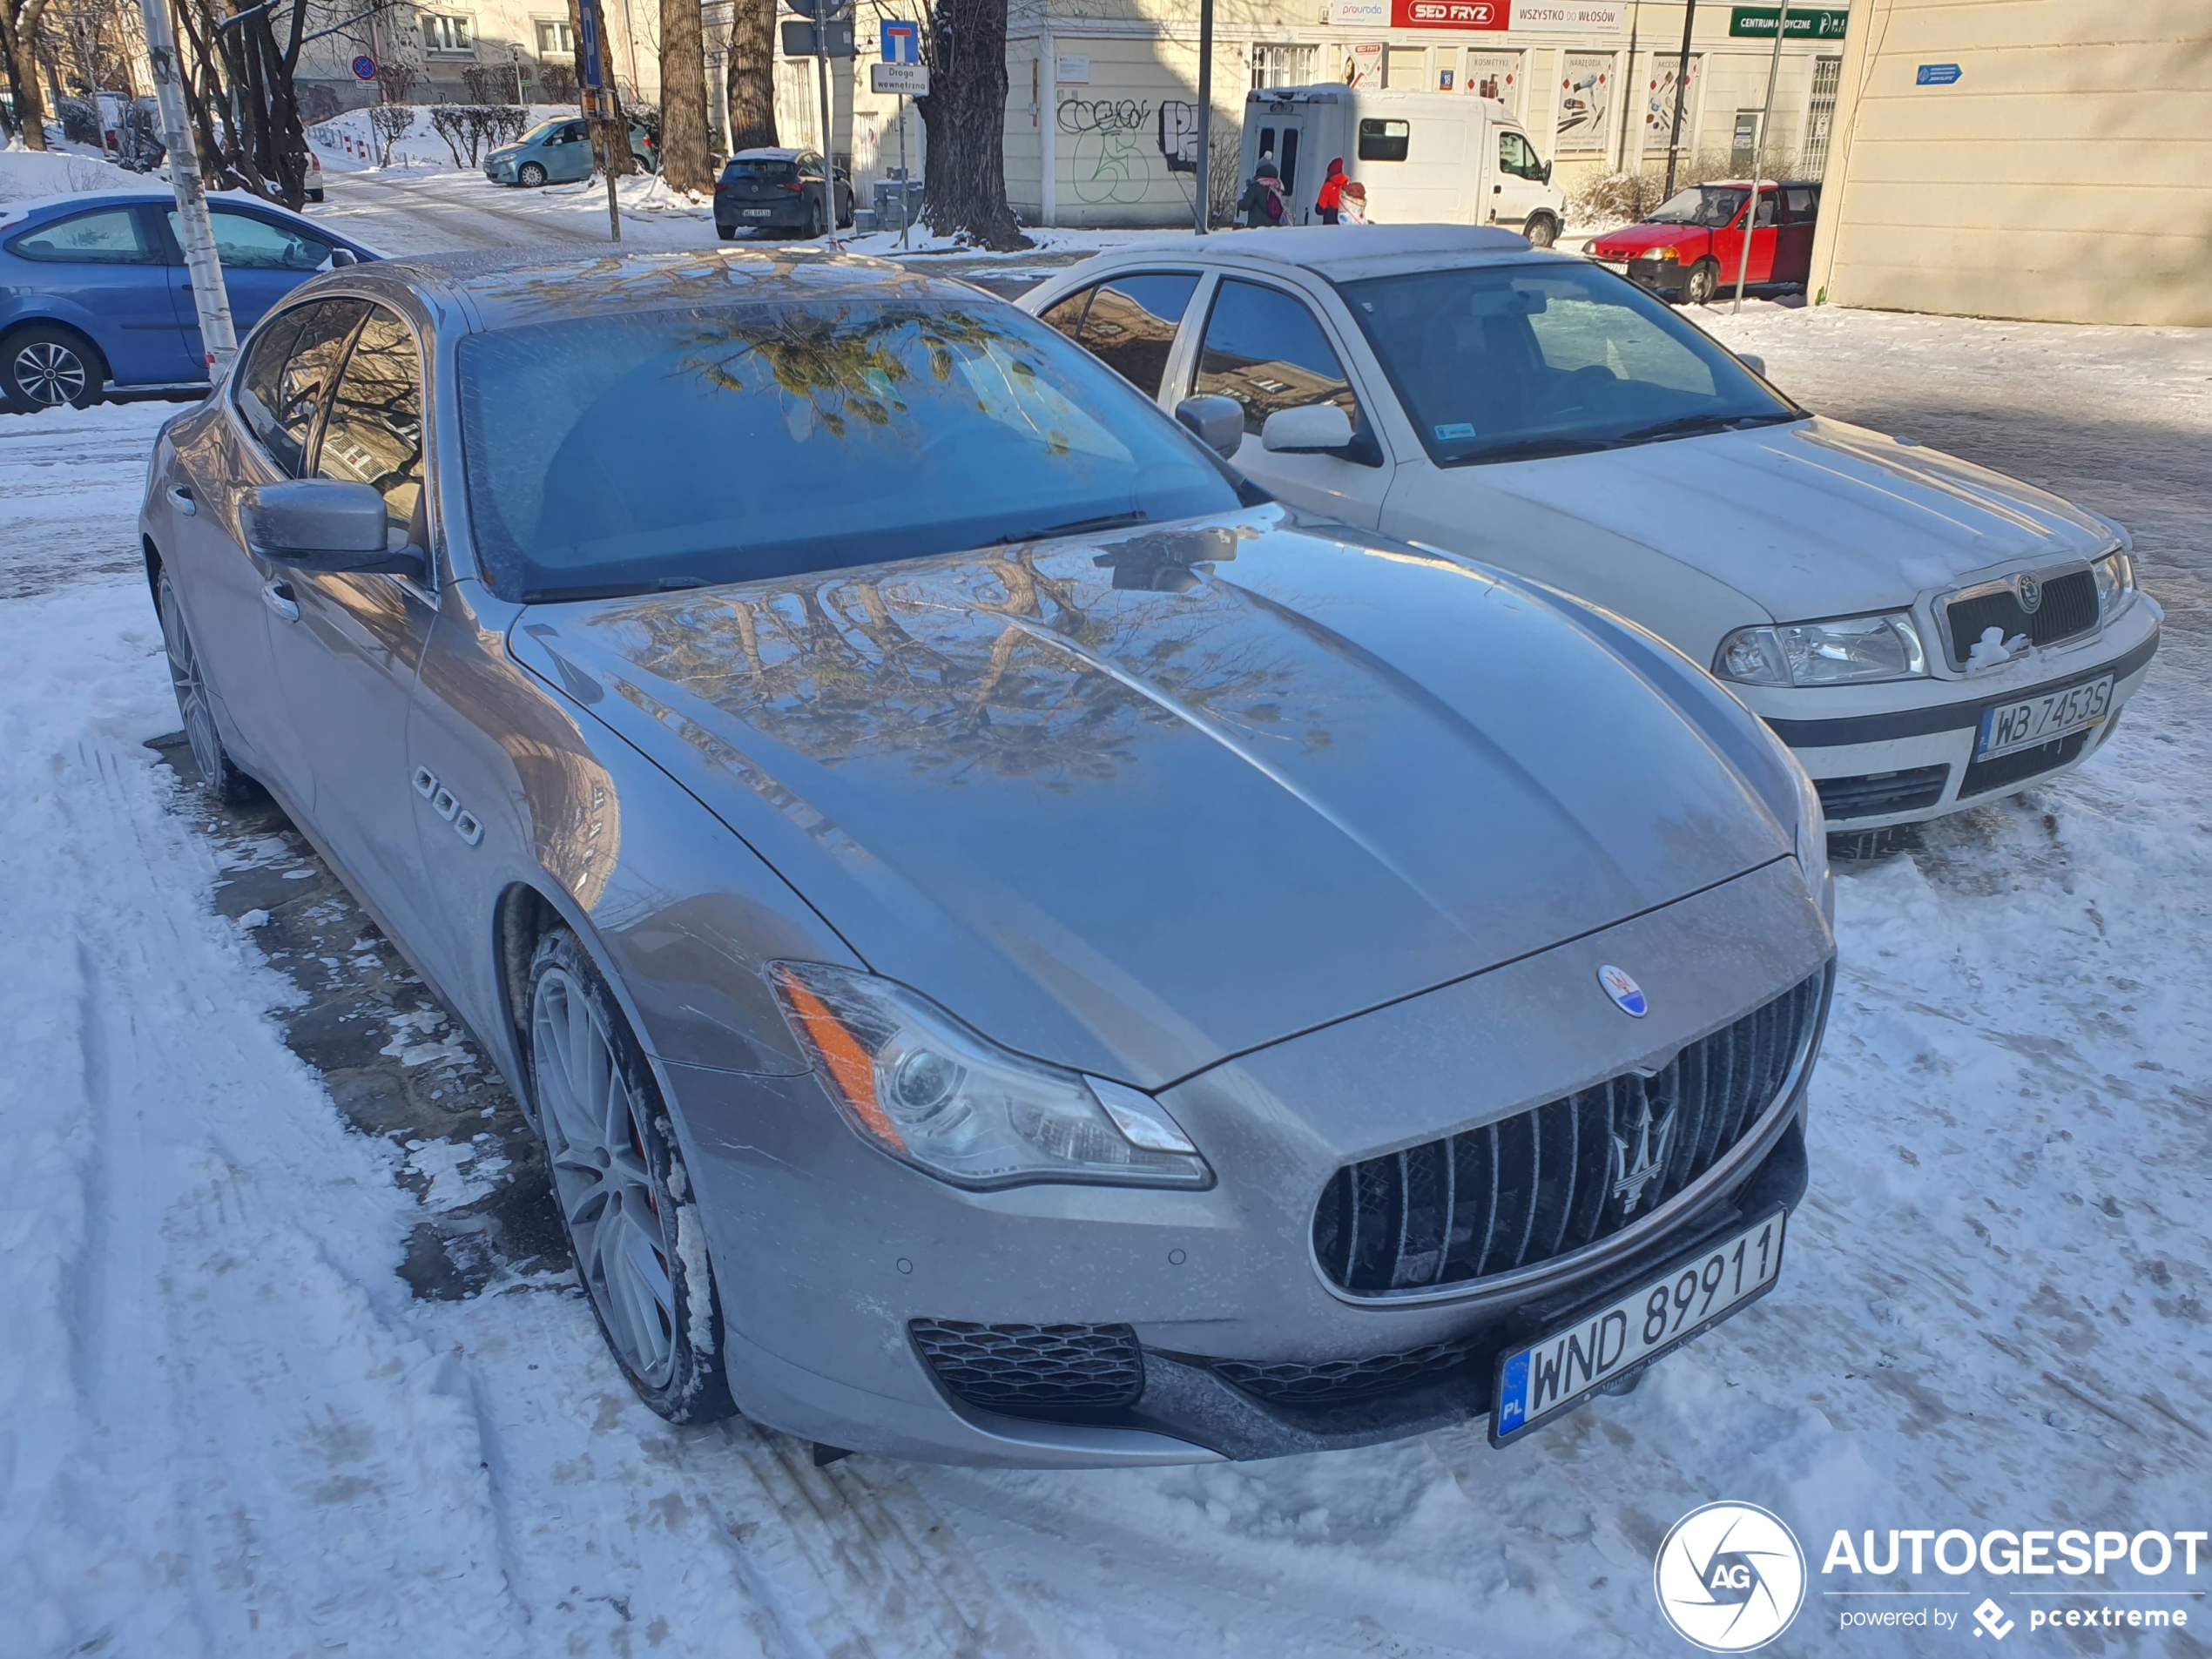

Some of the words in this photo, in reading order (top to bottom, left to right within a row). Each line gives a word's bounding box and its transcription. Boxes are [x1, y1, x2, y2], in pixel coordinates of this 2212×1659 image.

[1343, 3, 1382, 15] prouroda
[1415, 5, 1447, 18] SED
[1450, 7, 1487, 19] FRYZ
[1520, 9, 1564, 21] WSZYSTKO
[1567, 11, 1576, 21] DO
[1579, 9, 1615, 22] WŁOSÓW
[1741, 18, 1774, 28] CENTRUM
[1775, 19, 1811, 29] MDYCZNE
[1570, 59, 1601, 69] NARZĘDZIA
[889, 67, 914, 78] Droga
[1444, 74, 1451, 84] 18
[878, 81, 925, 91] wewnętrzna
[1995, 705, 2031, 746] WB
[2036, 681, 2107, 734] 7453S
[1503, 1399, 1522, 1420] PL
[1533, 1310, 1627, 1411] WND
[1642, 1224, 1772, 1345] 89911
